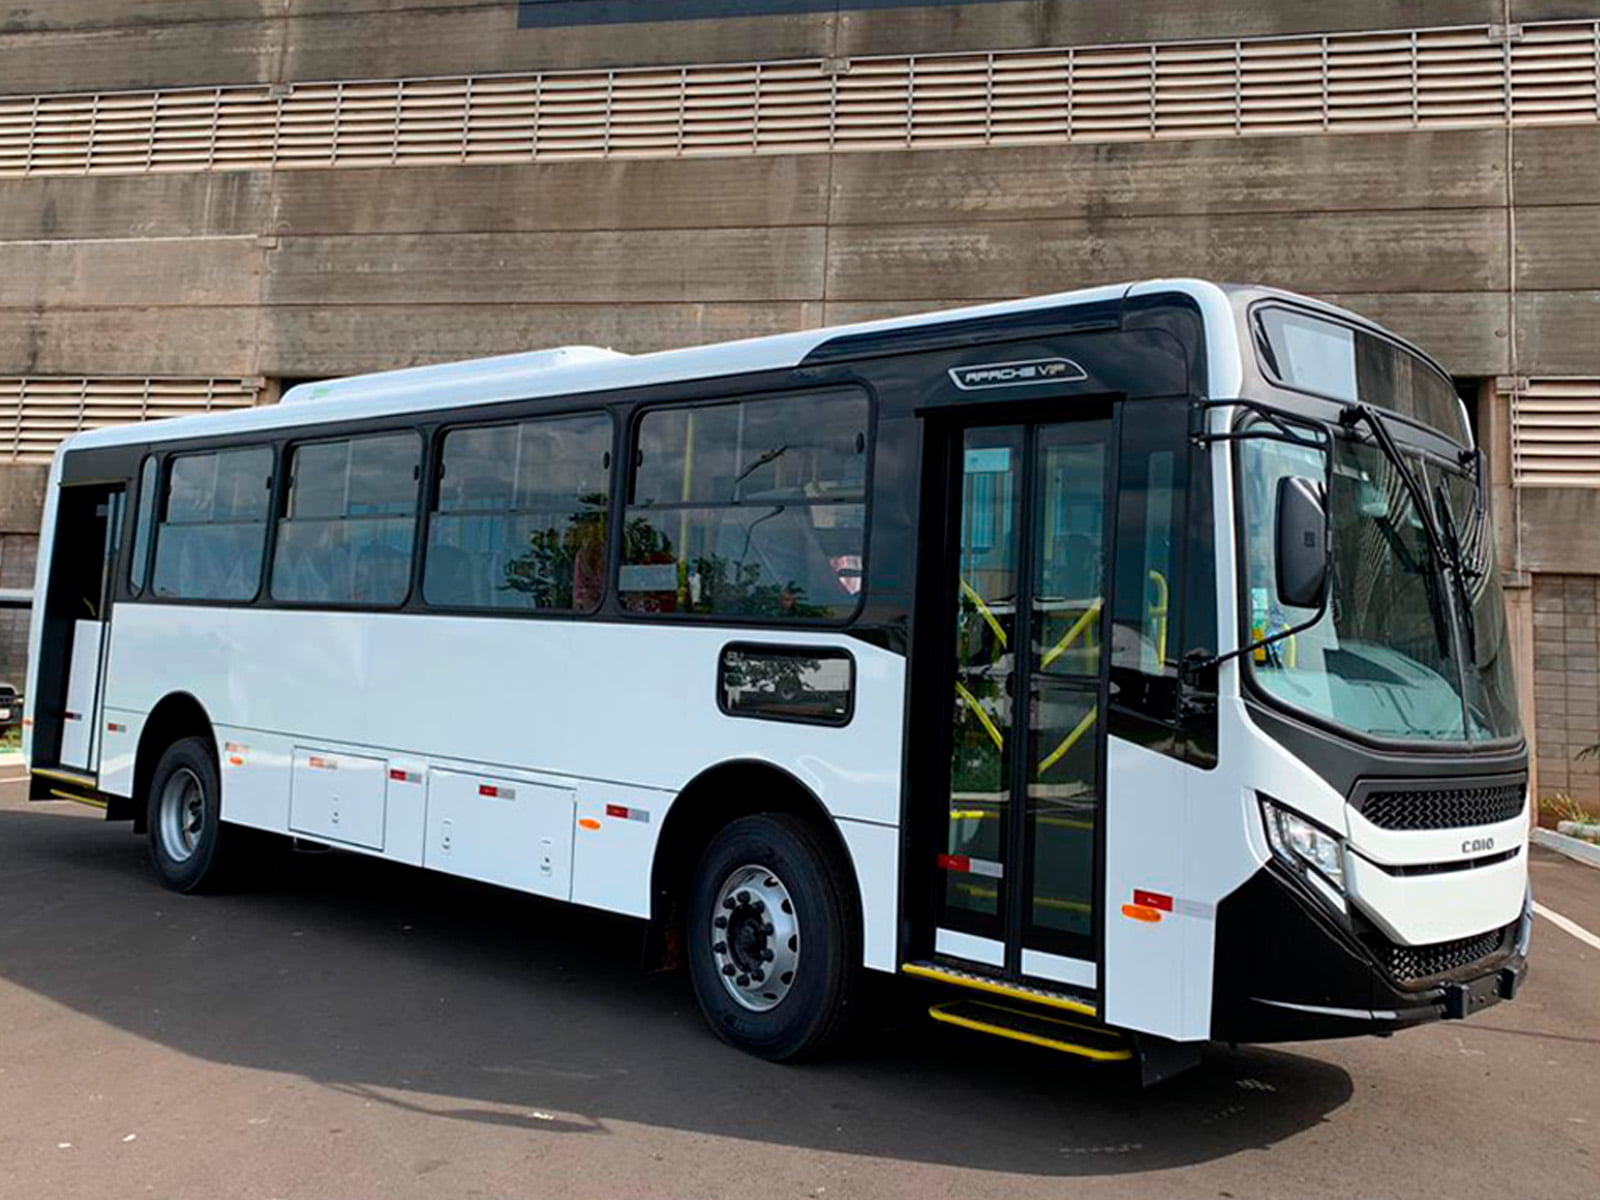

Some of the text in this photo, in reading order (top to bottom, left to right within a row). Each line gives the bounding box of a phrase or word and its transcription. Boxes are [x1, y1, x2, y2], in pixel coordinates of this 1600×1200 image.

[966, 364, 1065, 383] APACHE VIP
[1462, 838, 1494, 853] CAIO
